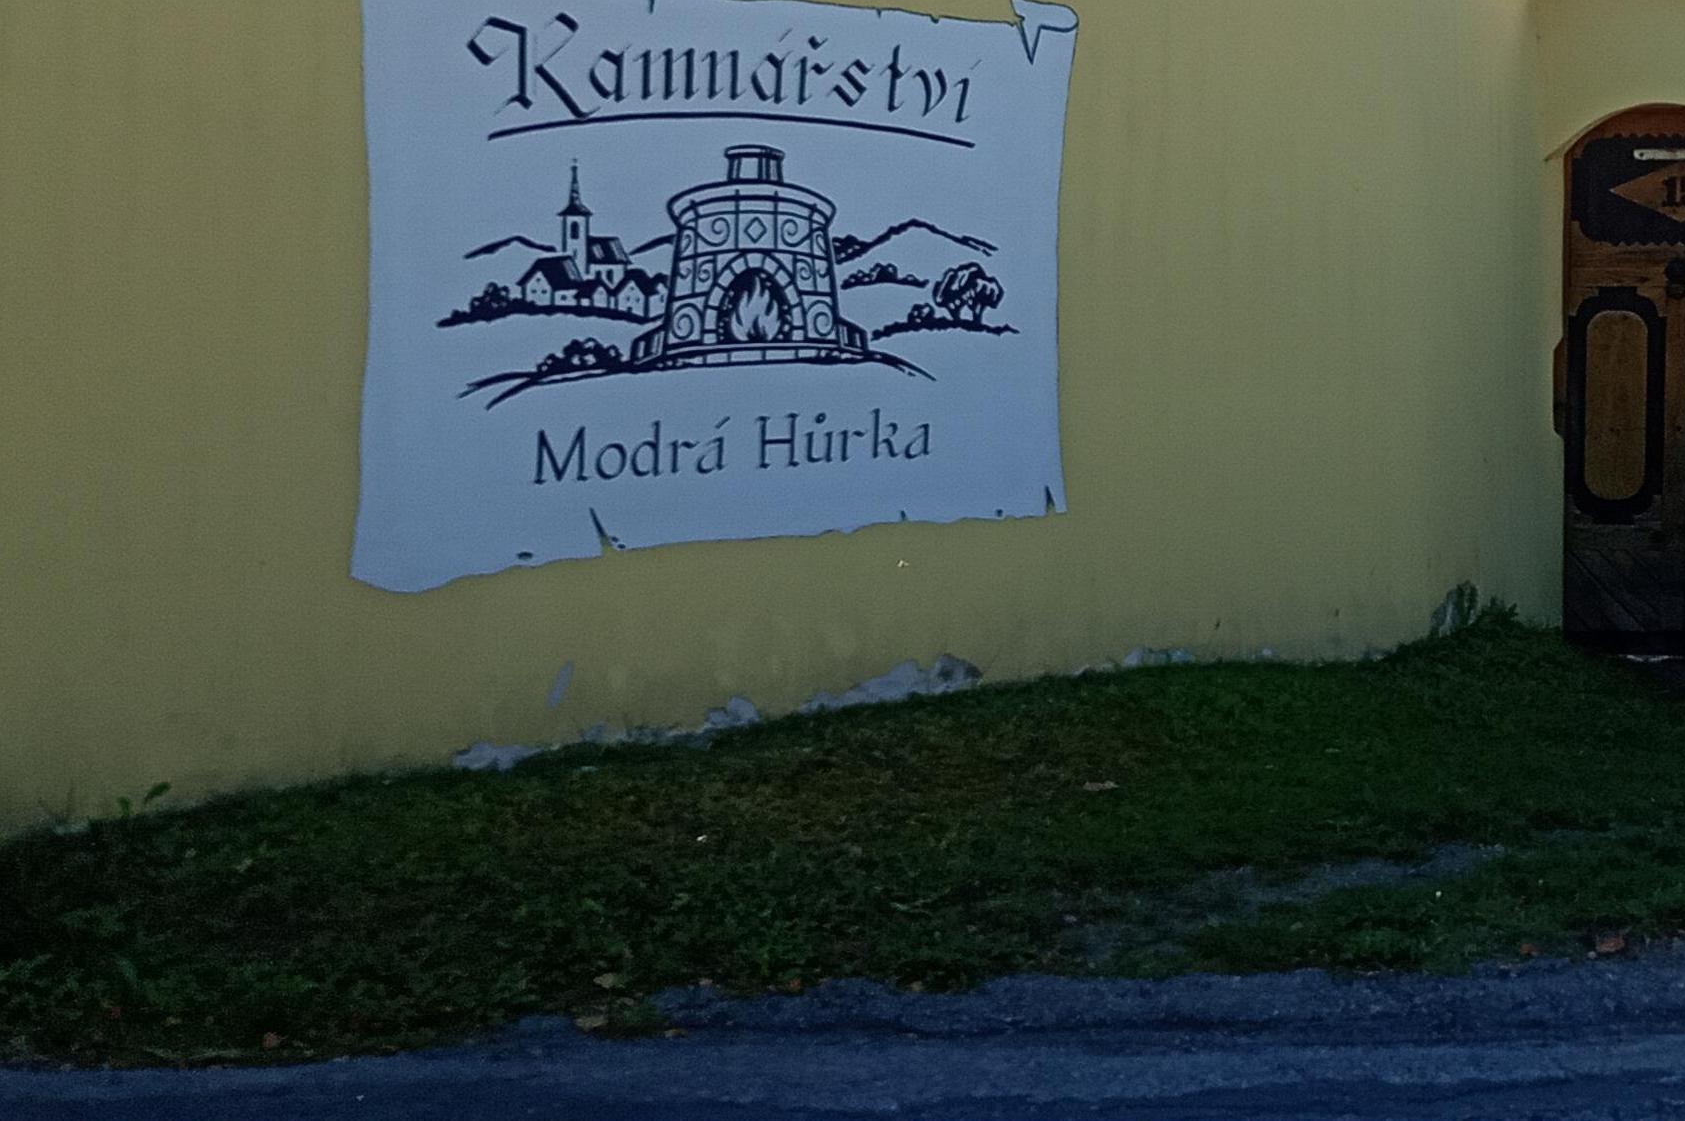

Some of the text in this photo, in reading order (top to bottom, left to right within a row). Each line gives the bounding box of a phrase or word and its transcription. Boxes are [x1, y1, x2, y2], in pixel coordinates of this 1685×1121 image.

[466, 13, 982, 123] Kamnářství
[534, 407, 932, 485] Modrá Hůrka
